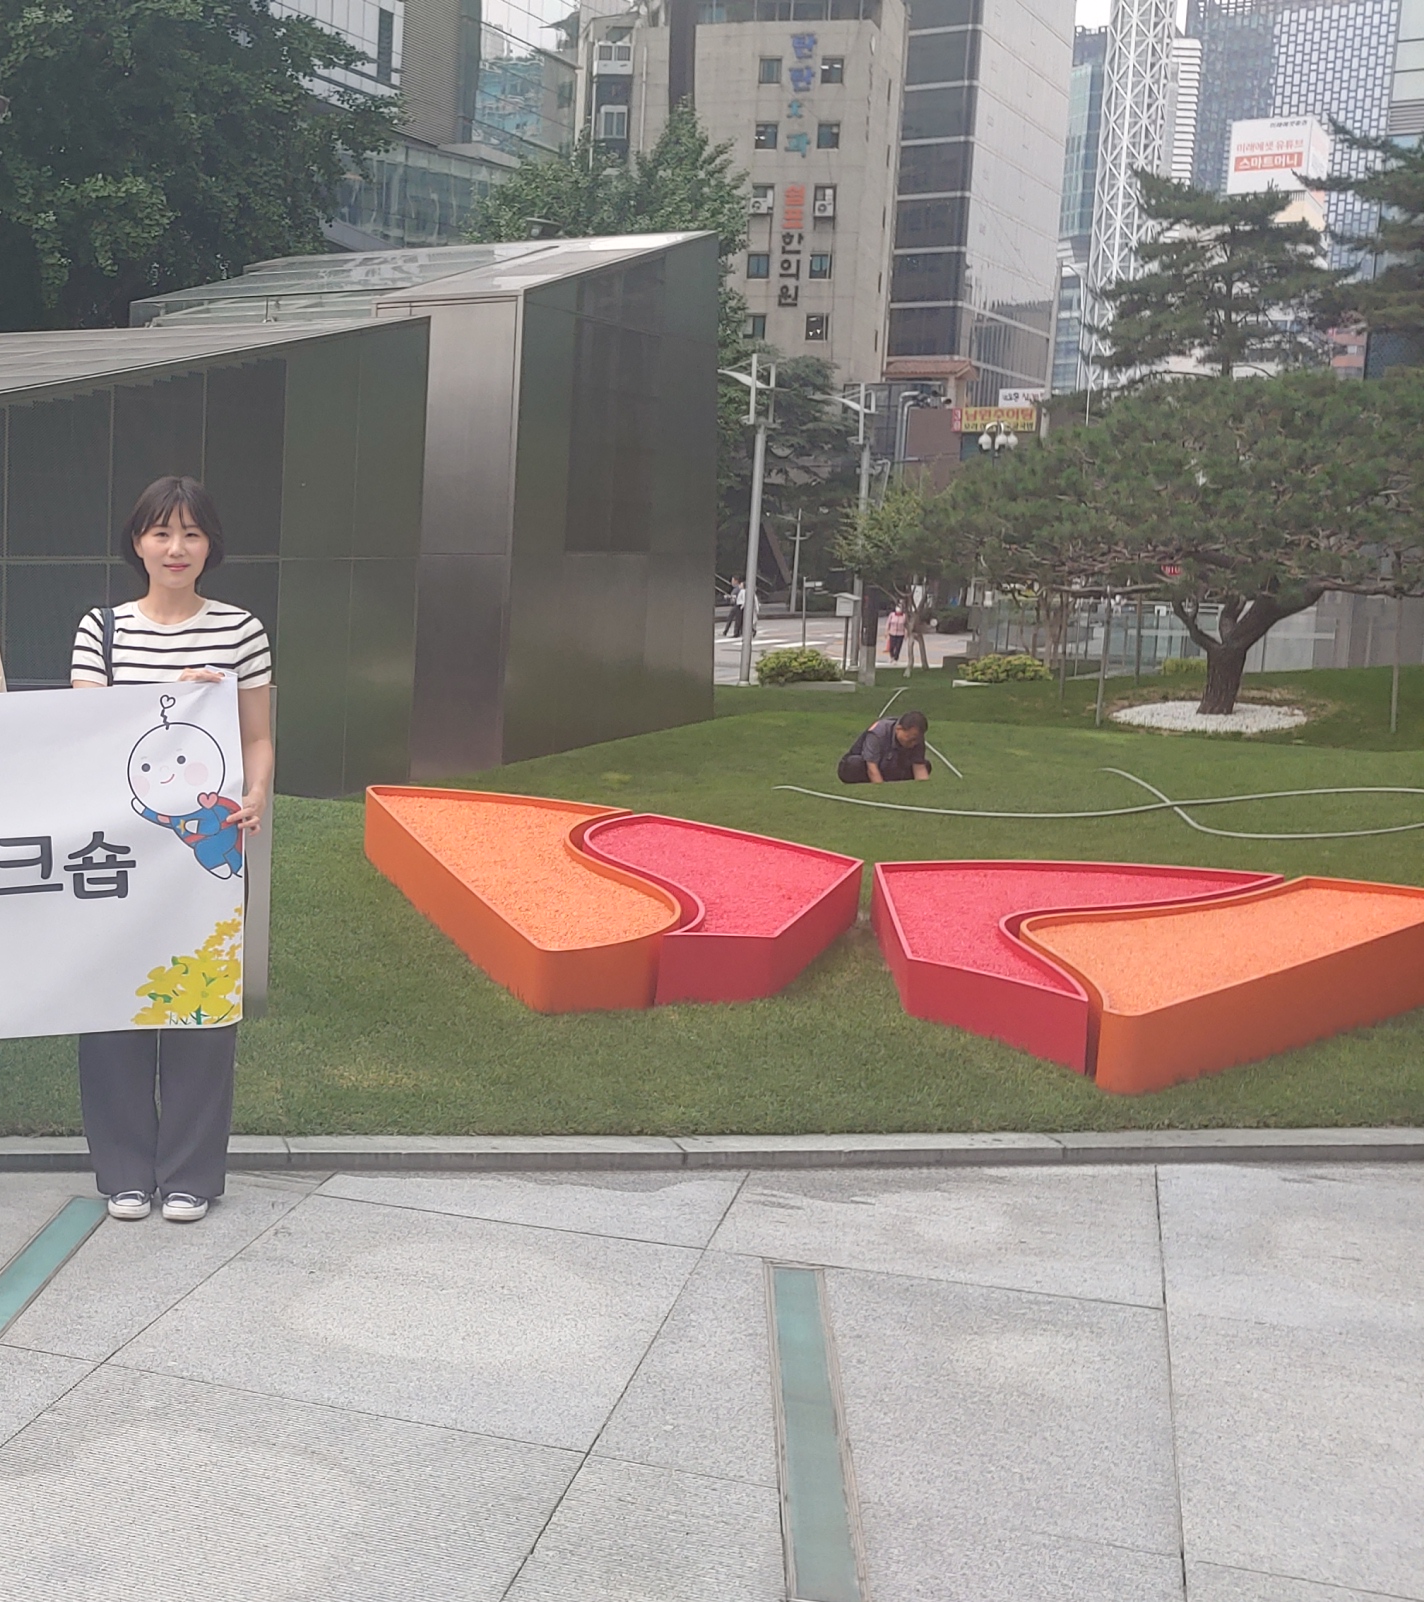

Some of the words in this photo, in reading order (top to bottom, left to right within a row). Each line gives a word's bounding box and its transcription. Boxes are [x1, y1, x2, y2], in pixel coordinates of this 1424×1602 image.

[1237, 142, 1274, 154] 미래에셋
[1276, 139, 1304, 151] 유튜브
[1239, 154, 1298, 169] 스마트머니
[964, 409, 1034, 421] 남원추어탕
